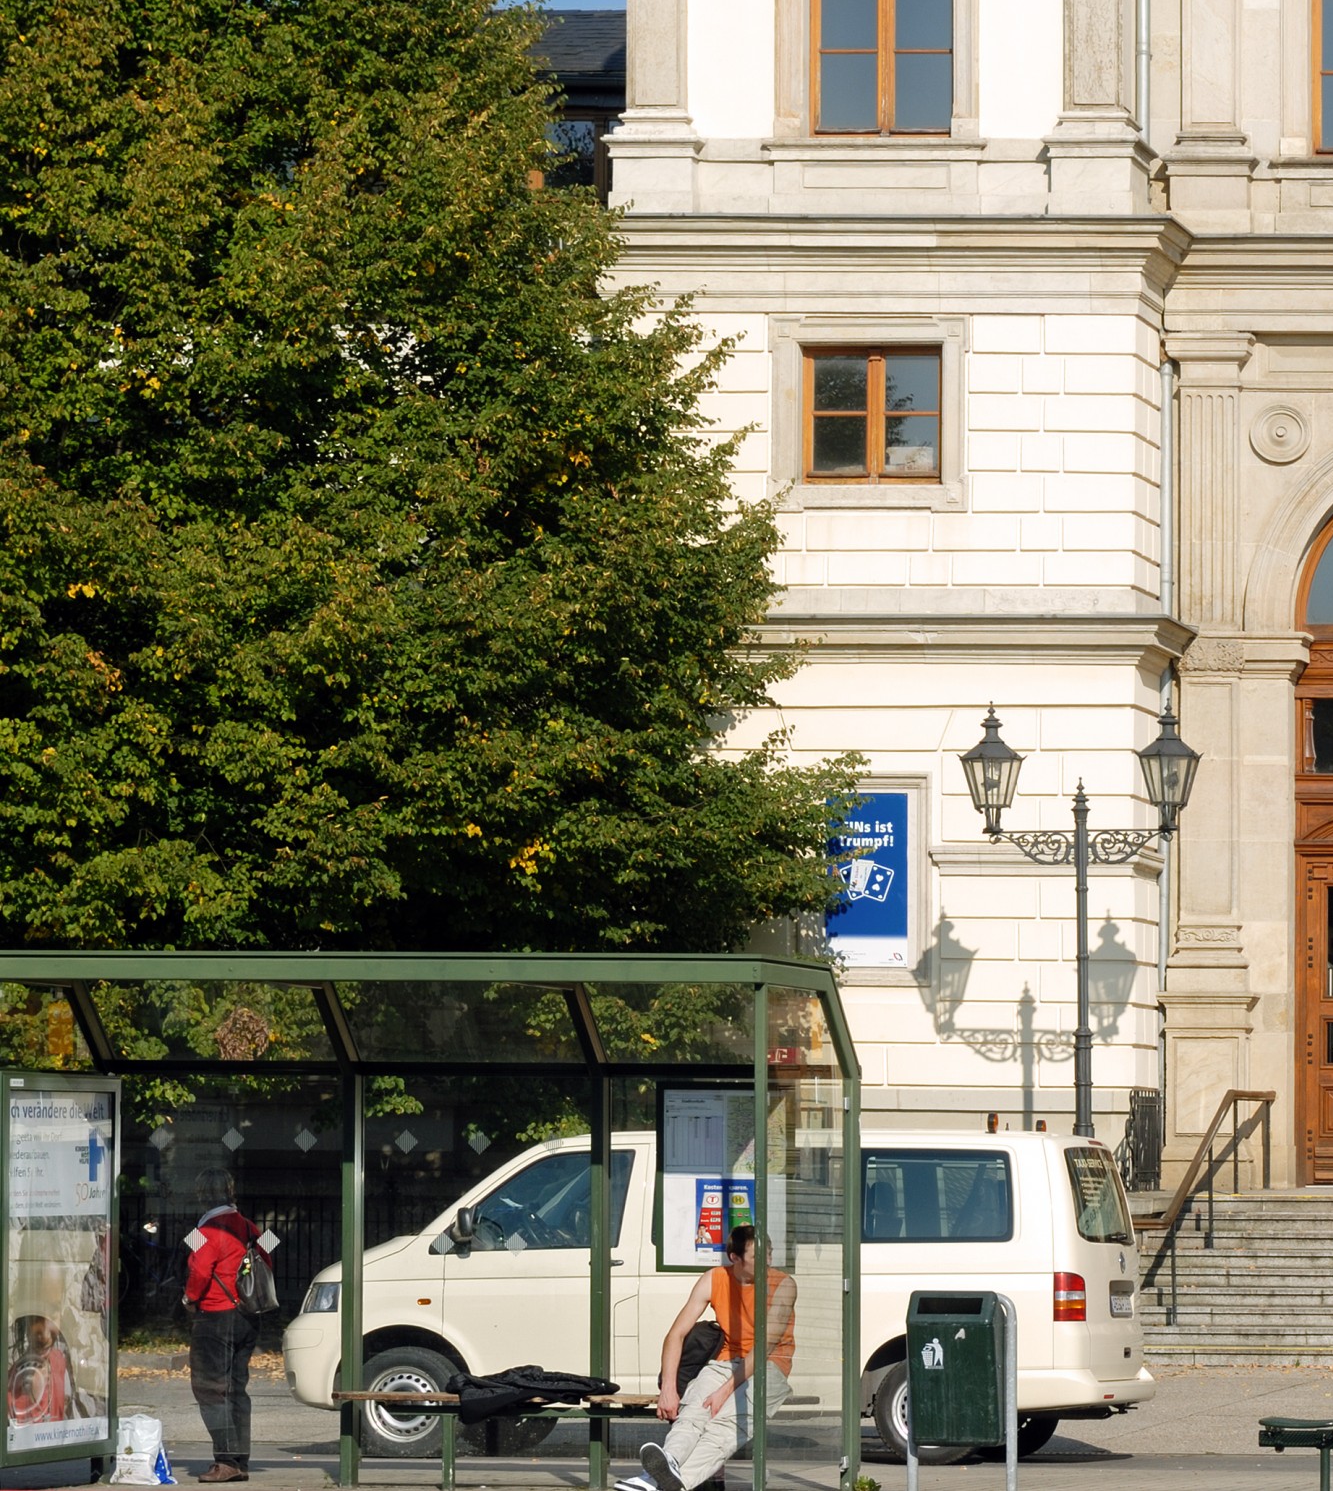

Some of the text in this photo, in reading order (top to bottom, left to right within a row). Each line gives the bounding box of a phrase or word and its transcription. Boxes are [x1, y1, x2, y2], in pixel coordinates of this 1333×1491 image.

[875, 820, 893, 834] ist
[839, 834, 894, 850] Trumpf!
[11, 1101, 20, 1119] ch
[23, 1100, 67, 1119] verändere
[69, 1102, 82, 1119] die
